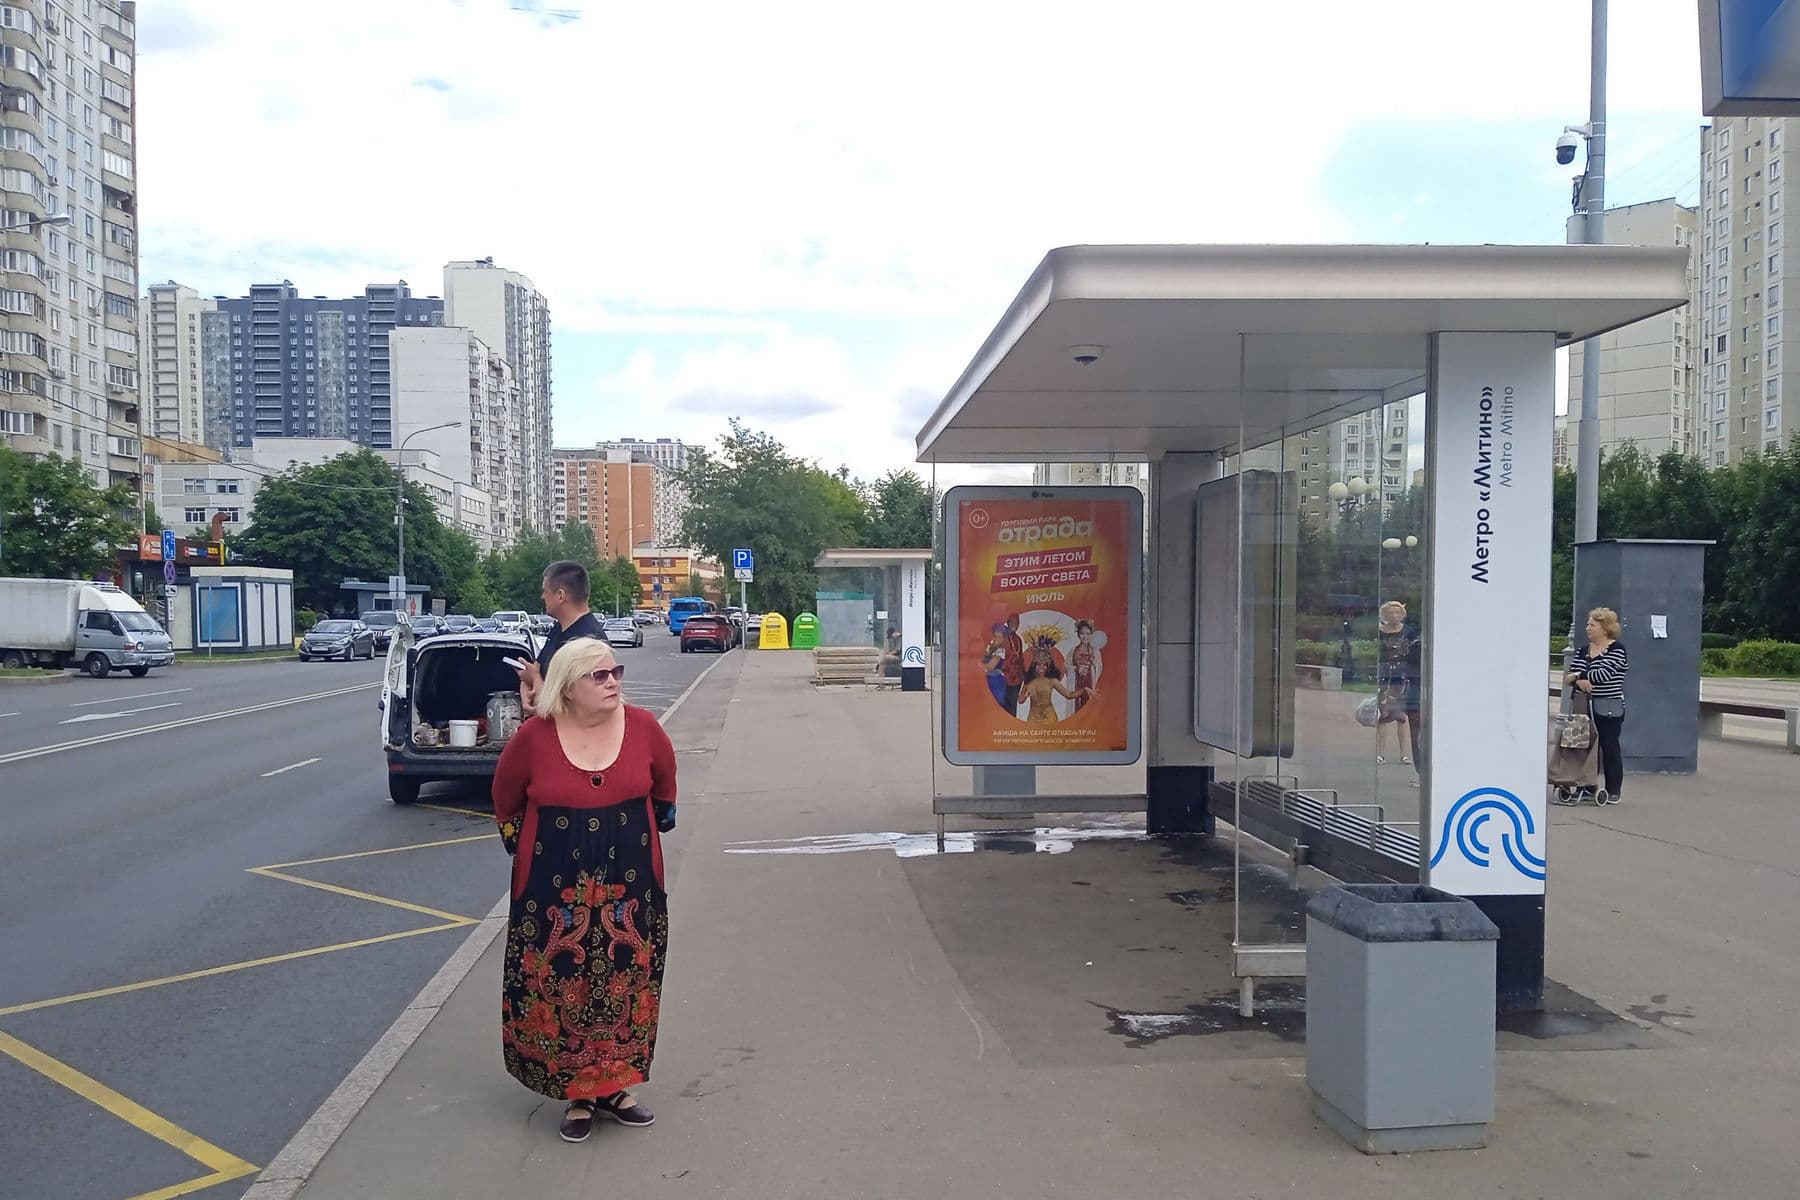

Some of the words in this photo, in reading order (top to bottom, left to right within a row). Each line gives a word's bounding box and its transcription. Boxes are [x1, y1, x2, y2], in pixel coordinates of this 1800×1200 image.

[1500, 386, 1514, 436] Mitino
[1473, 386, 1493, 501] «Митино»
[1499, 441, 1513, 488] Metro
[972, 513, 986, 524] 0+
[1471, 508, 1493, 584] Метро
[737, 551, 747, 566] P
[1004, 556, 1040, 568] ЭТИМ
[1042, 551, 1085, 565] ЛЕТОМ
[1000, 573, 1048, 588] ВОКРУГ
[1051, 569, 1090, 583] СВЕТА
[1026, 591, 1065, 604] ИЮЛЬ
